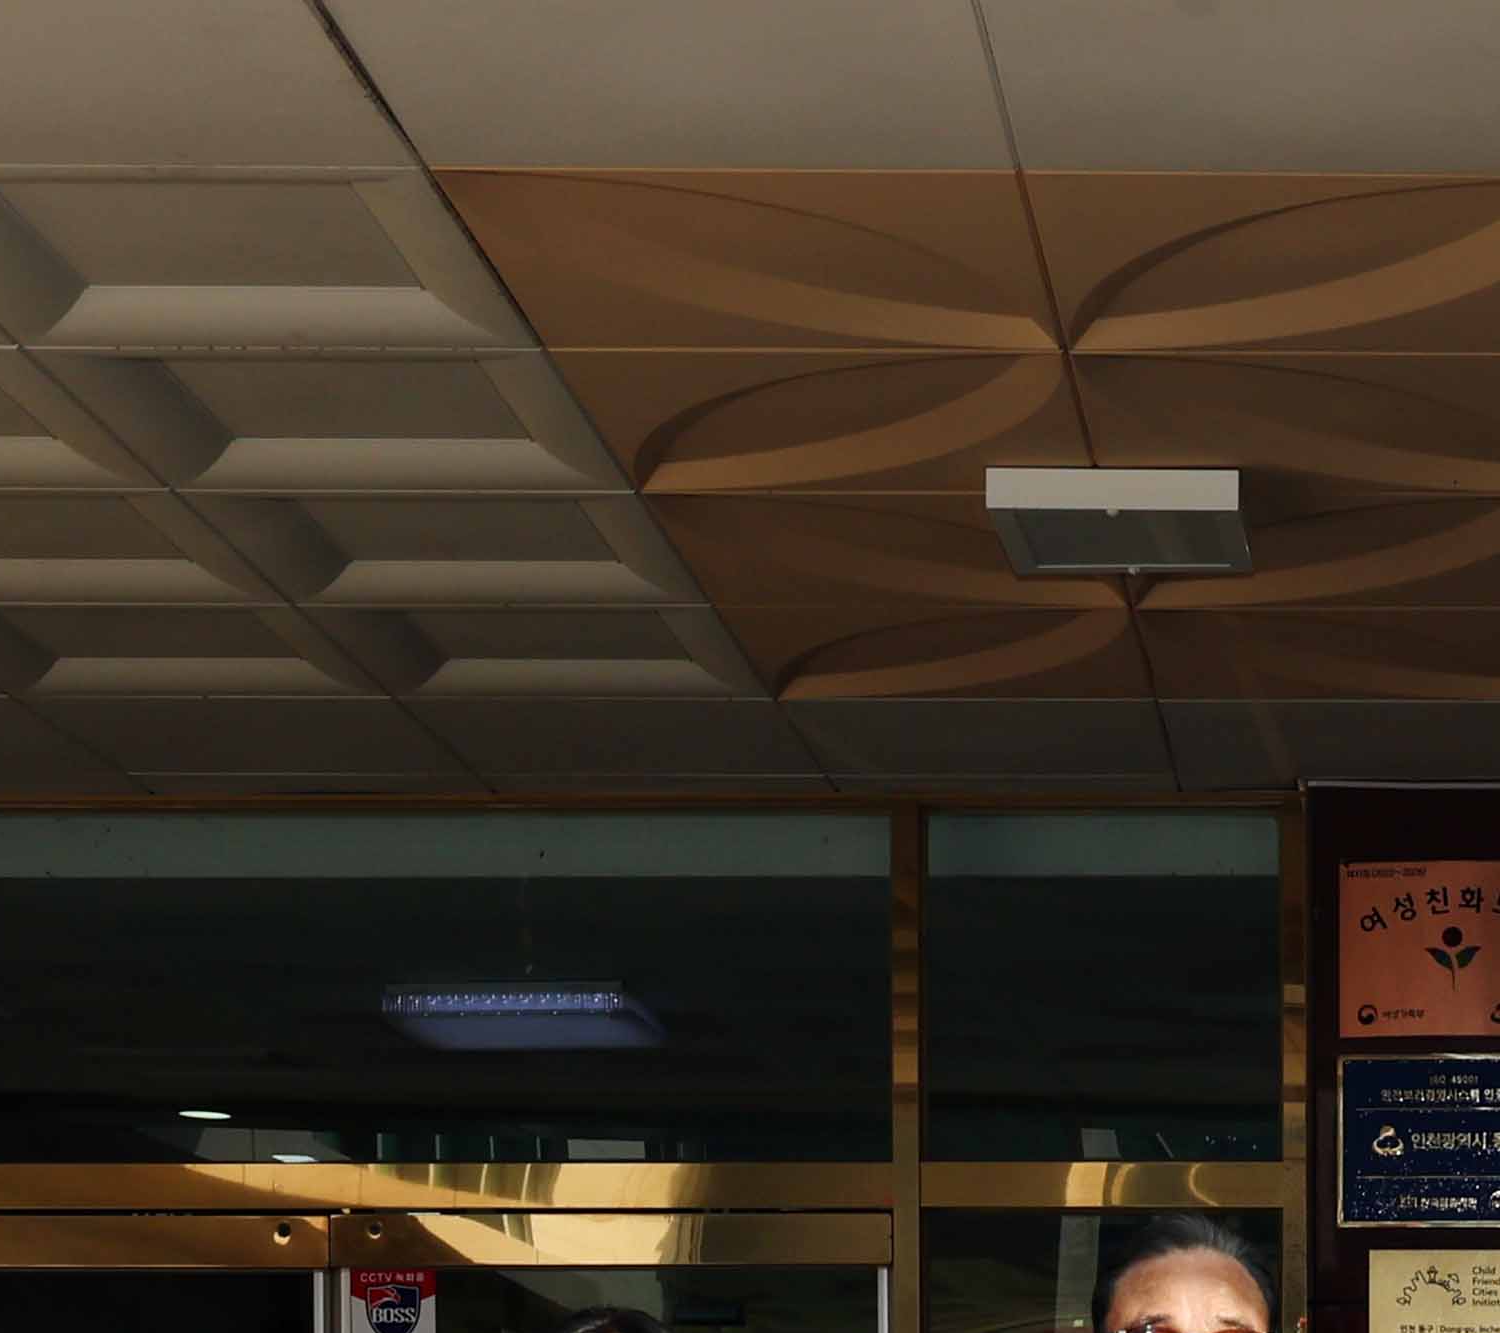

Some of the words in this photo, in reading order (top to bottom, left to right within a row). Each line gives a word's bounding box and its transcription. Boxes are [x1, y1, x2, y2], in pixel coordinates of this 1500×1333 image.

[1411, 1132, 1487, 1149] 인천광역시
[1472, 1266, 1496, 1275] Child
[360, 1272, 392, 1282] CCTV
[1472, 1288, 1498, 1296] Cities
[372, 1307, 415, 1323] BOSS
